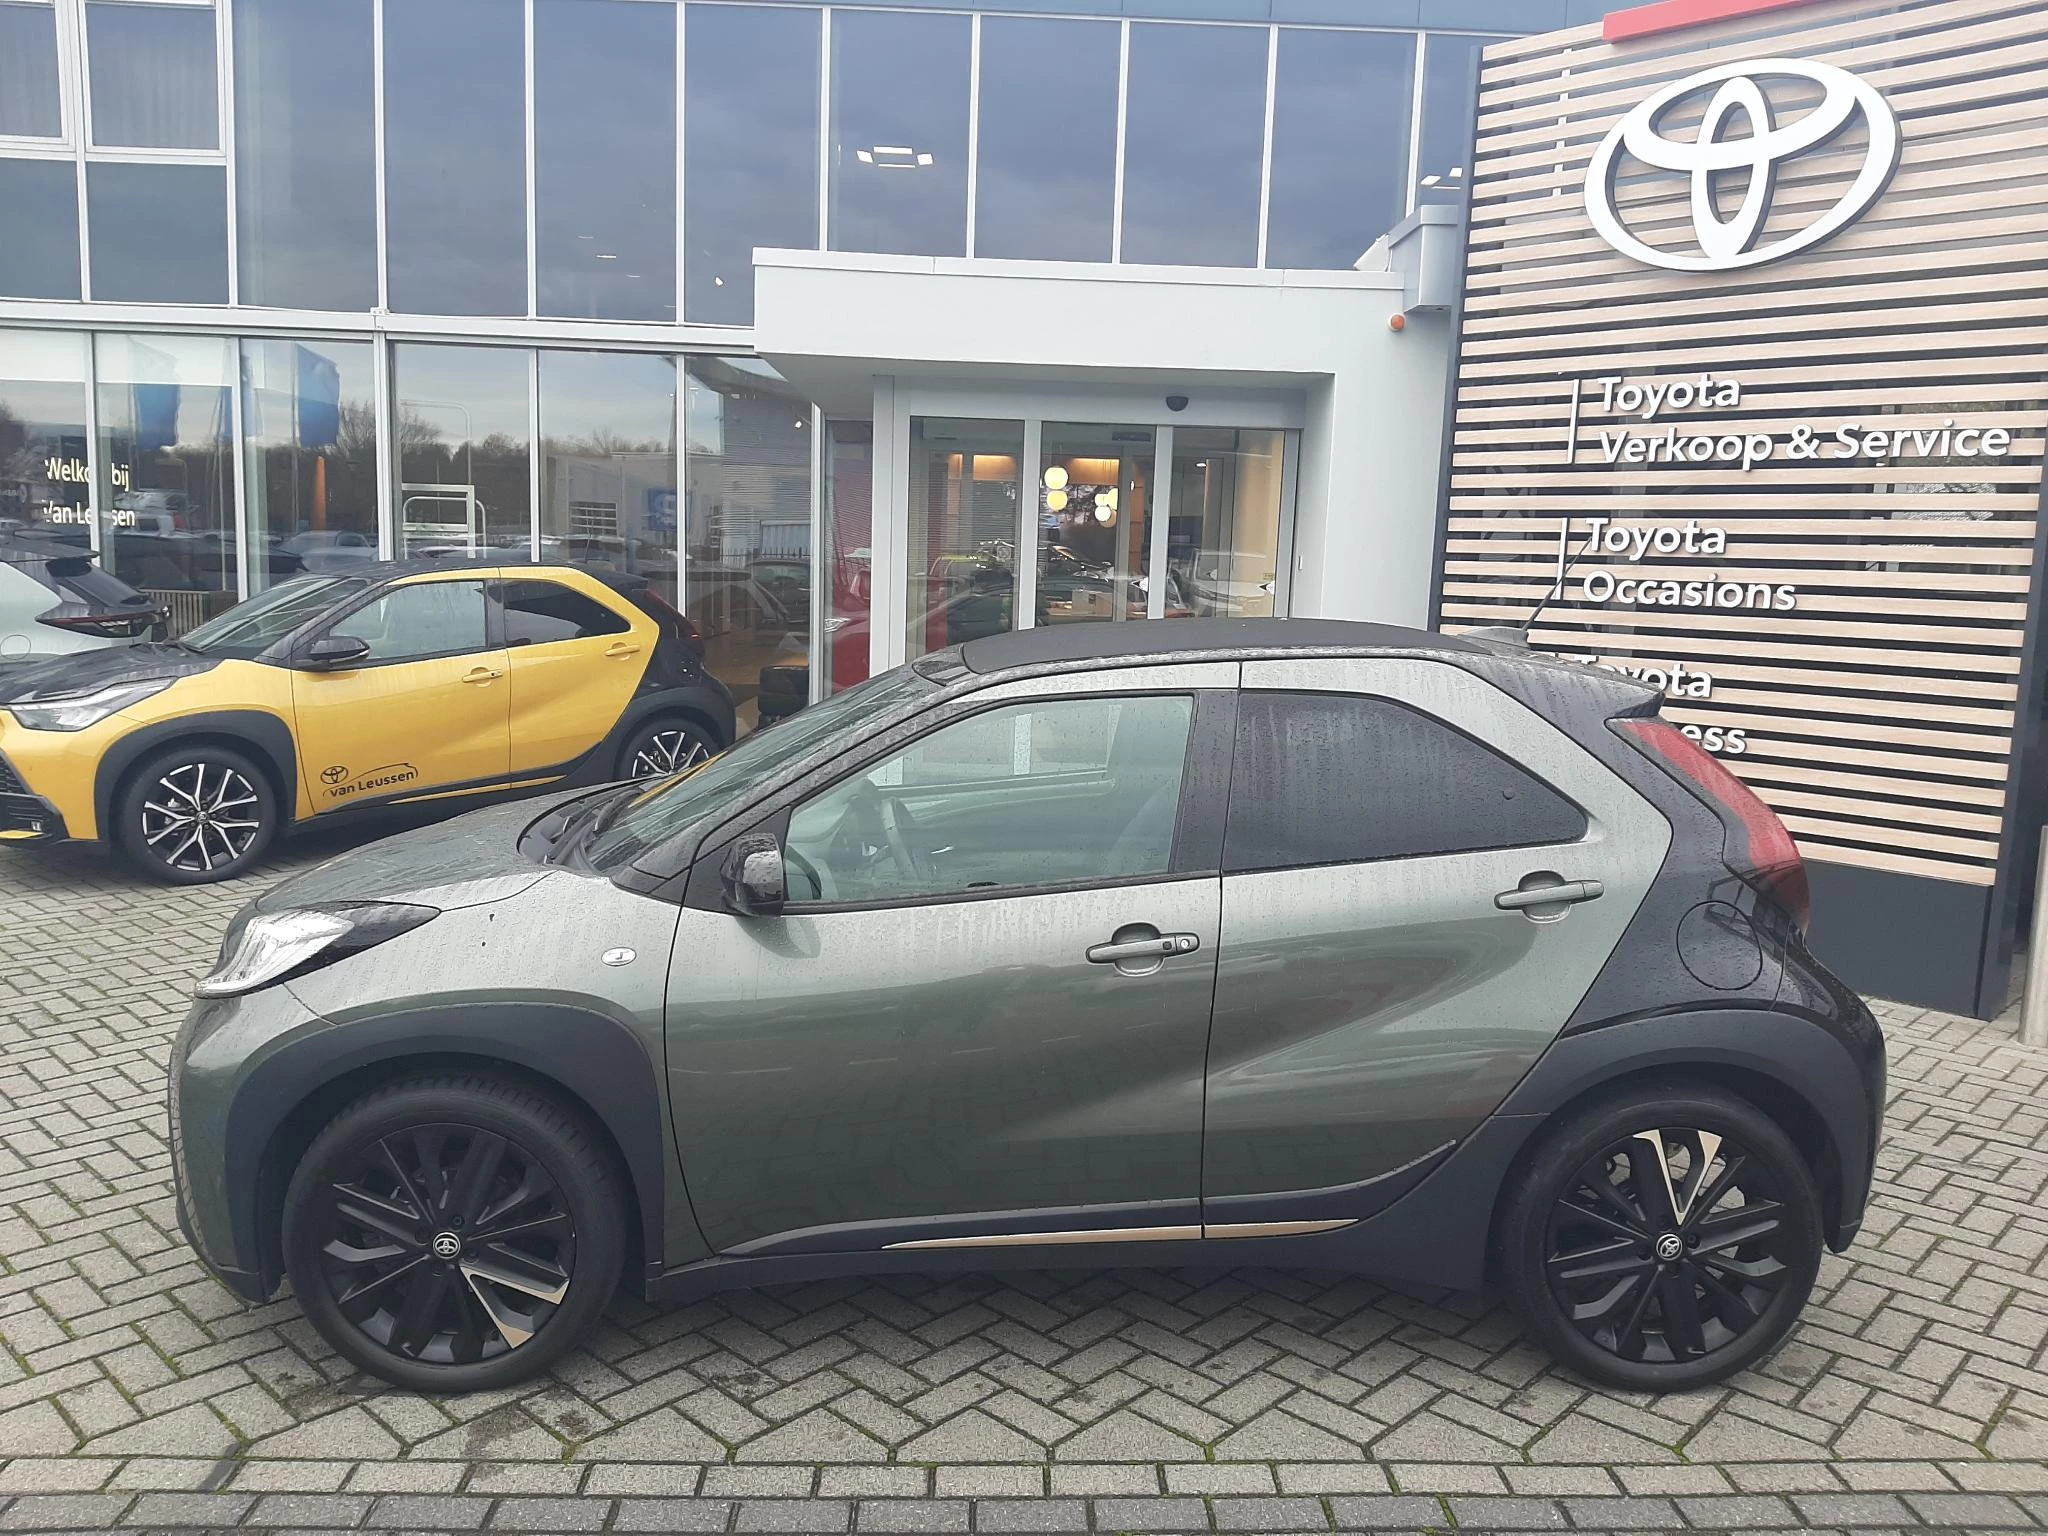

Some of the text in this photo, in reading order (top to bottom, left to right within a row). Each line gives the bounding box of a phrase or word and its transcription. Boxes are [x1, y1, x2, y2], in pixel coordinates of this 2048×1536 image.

[1598, 374, 1740, 419] Toyota
[1600, 418, 2010, 471] Verkoop & Service
[111, 463, 129, 492] bij
[1585, 517, 1727, 561] Toyota
[1583, 570, 1797, 611] Occasions
[330, 771, 415, 797] van Leussen
